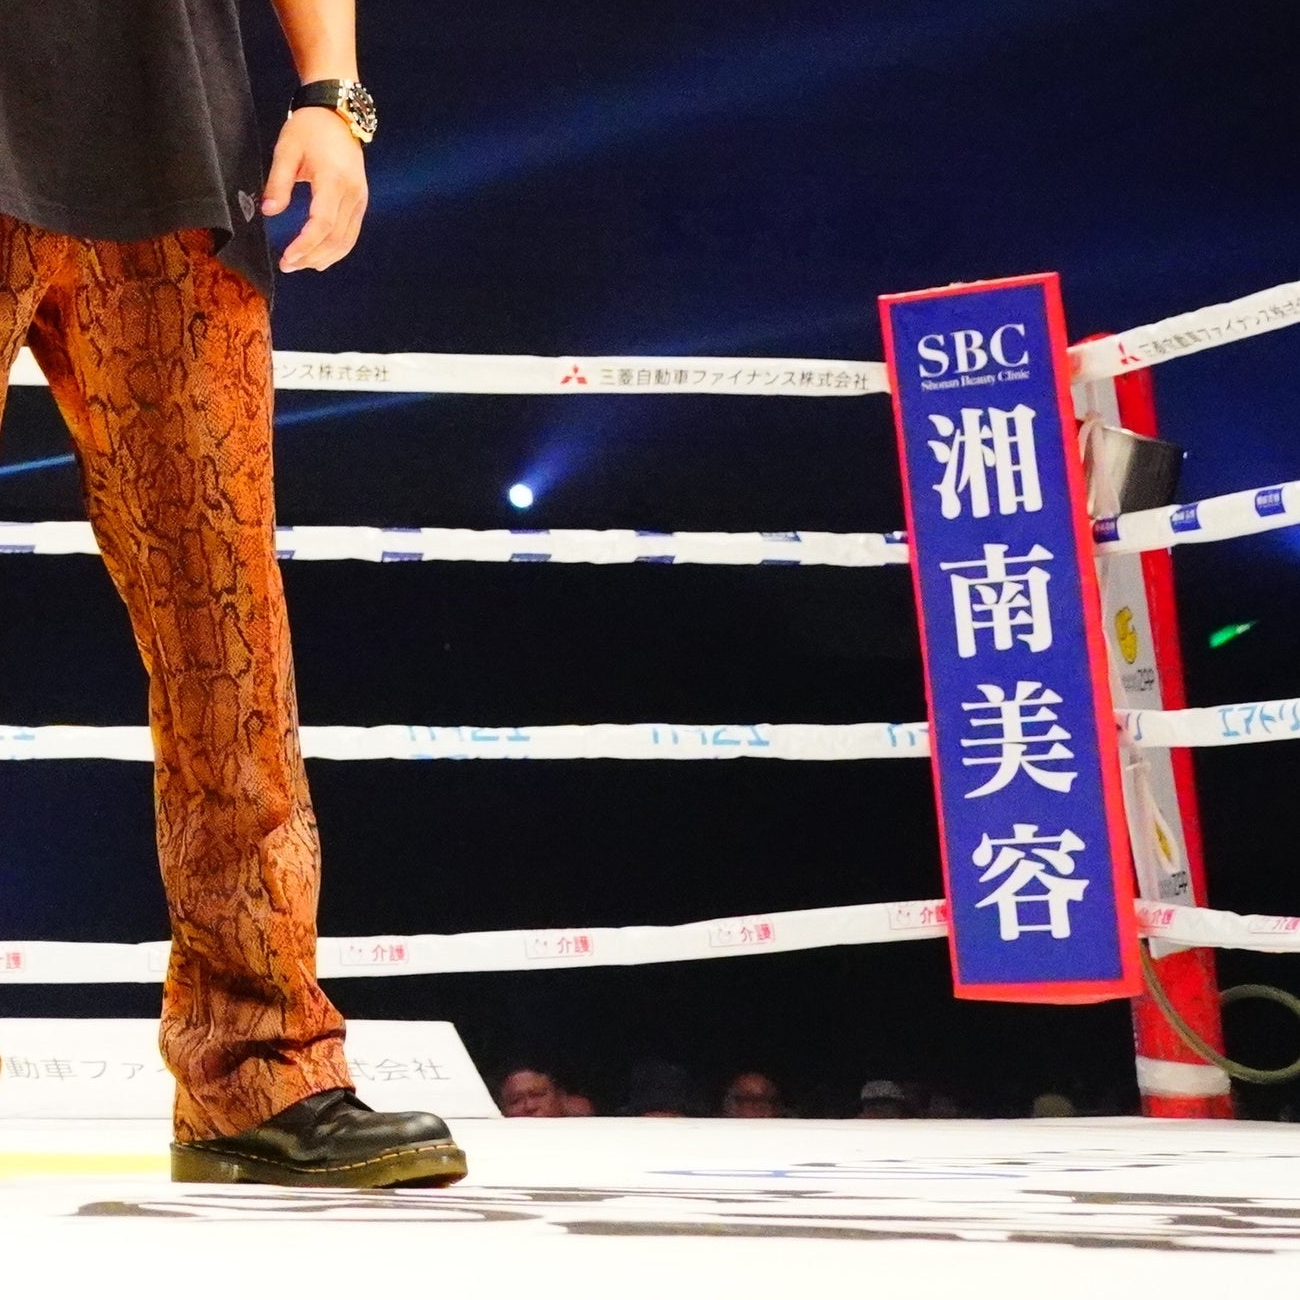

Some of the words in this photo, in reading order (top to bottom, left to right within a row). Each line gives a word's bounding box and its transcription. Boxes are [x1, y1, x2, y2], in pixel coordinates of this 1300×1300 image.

[917, 323, 1029, 378] SBC
[273, 364, 391, 383] ンス株式会社
[599, 367, 870, 391] 三菱自動車ファイナンス株式会社
[926, 403, 1091, 942] 湘南美容
[740, 922, 772, 943] 介護
[372, 943, 407, 964] 介護
[556, 936, 592, 956] 介護
